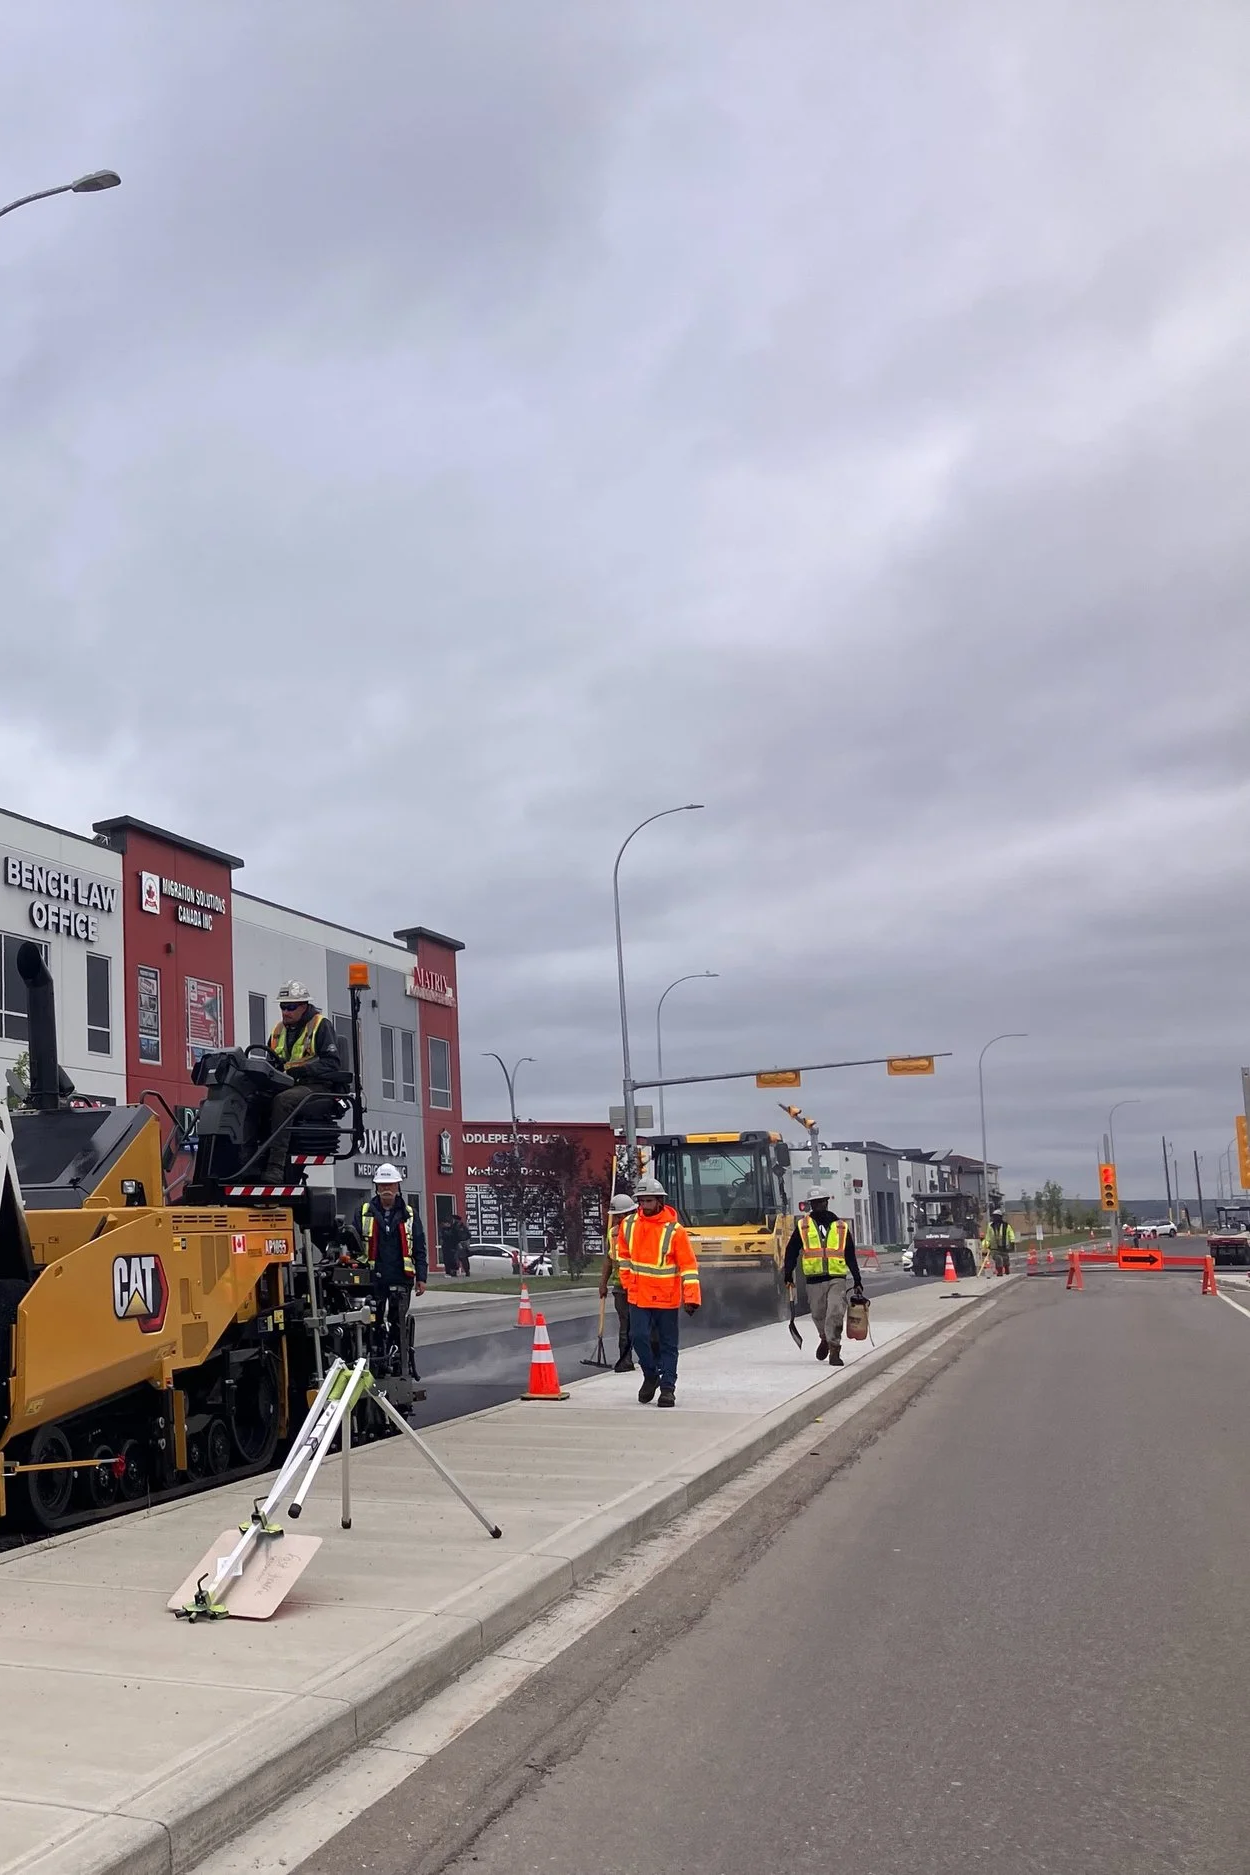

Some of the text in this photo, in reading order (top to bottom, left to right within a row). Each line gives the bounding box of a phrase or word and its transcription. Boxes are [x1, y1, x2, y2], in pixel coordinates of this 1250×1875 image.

[5, 856, 117, 913] BENCH LAW
[161, 877, 226, 915] MIGRATION SOLUTIONS
[30, 900, 99, 942] OFFICE
[177, 905, 213, 931] CANADA INC
[357, 1163, 379, 1177] MEDIC
[113, 1256, 156, 1319] CAT
